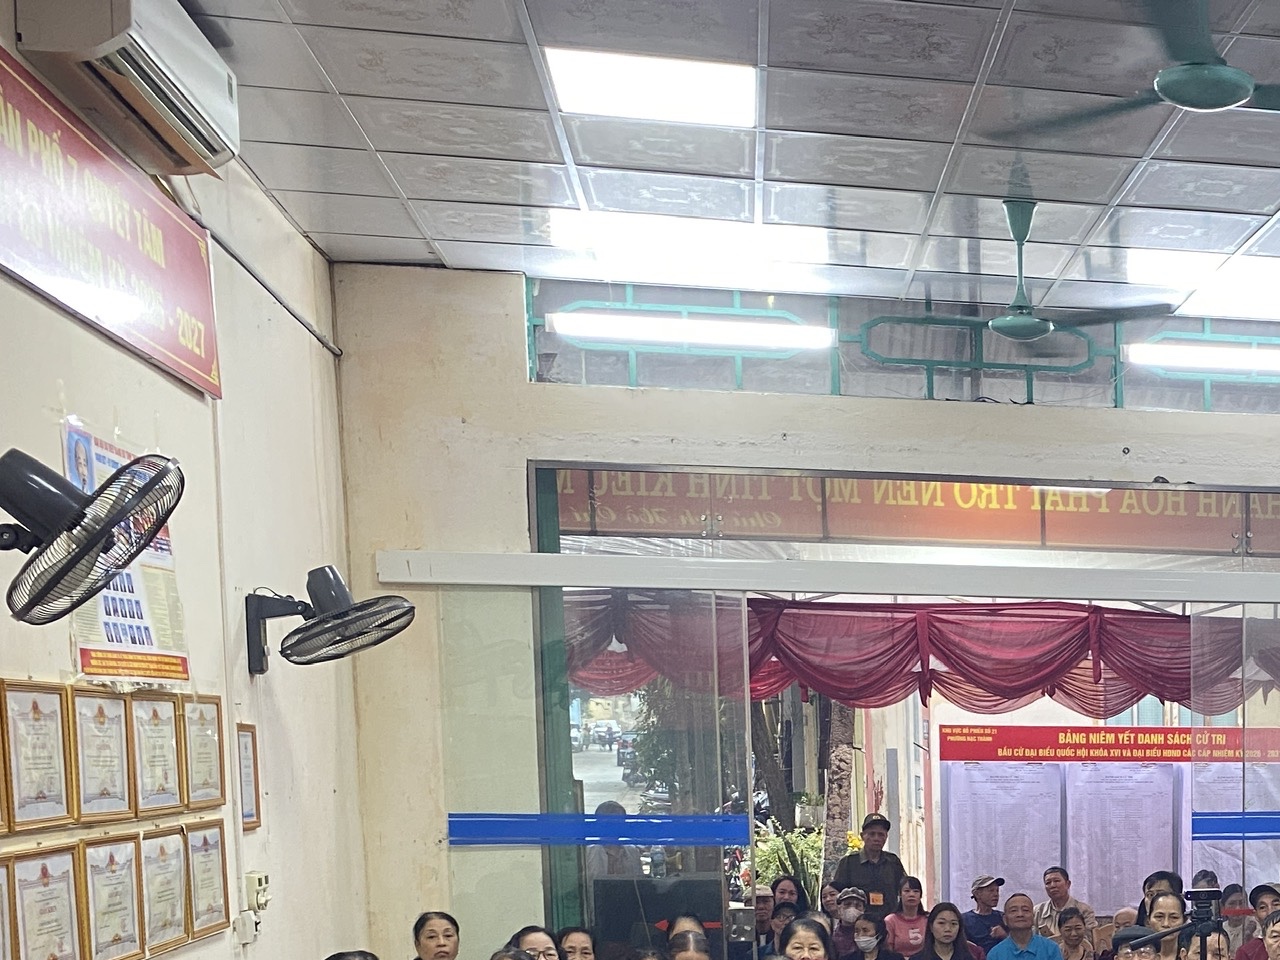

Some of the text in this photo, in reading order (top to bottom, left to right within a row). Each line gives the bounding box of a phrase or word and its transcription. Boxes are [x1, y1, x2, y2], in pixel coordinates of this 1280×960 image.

[133, 207, 166, 269] TÂM
[176, 306, 205, 358] 2027
[1056, 746, 1075, 757] QUỐC
[1077, 747, 1088, 758] HỘI
[1123, 747, 1131, 757] VÀ
[1182, 747, 1196, 757] CÁC
[1059, 729, 1226, 744] BẢNG NIÊM YẾT DANH SÁCH CỬ TRI
